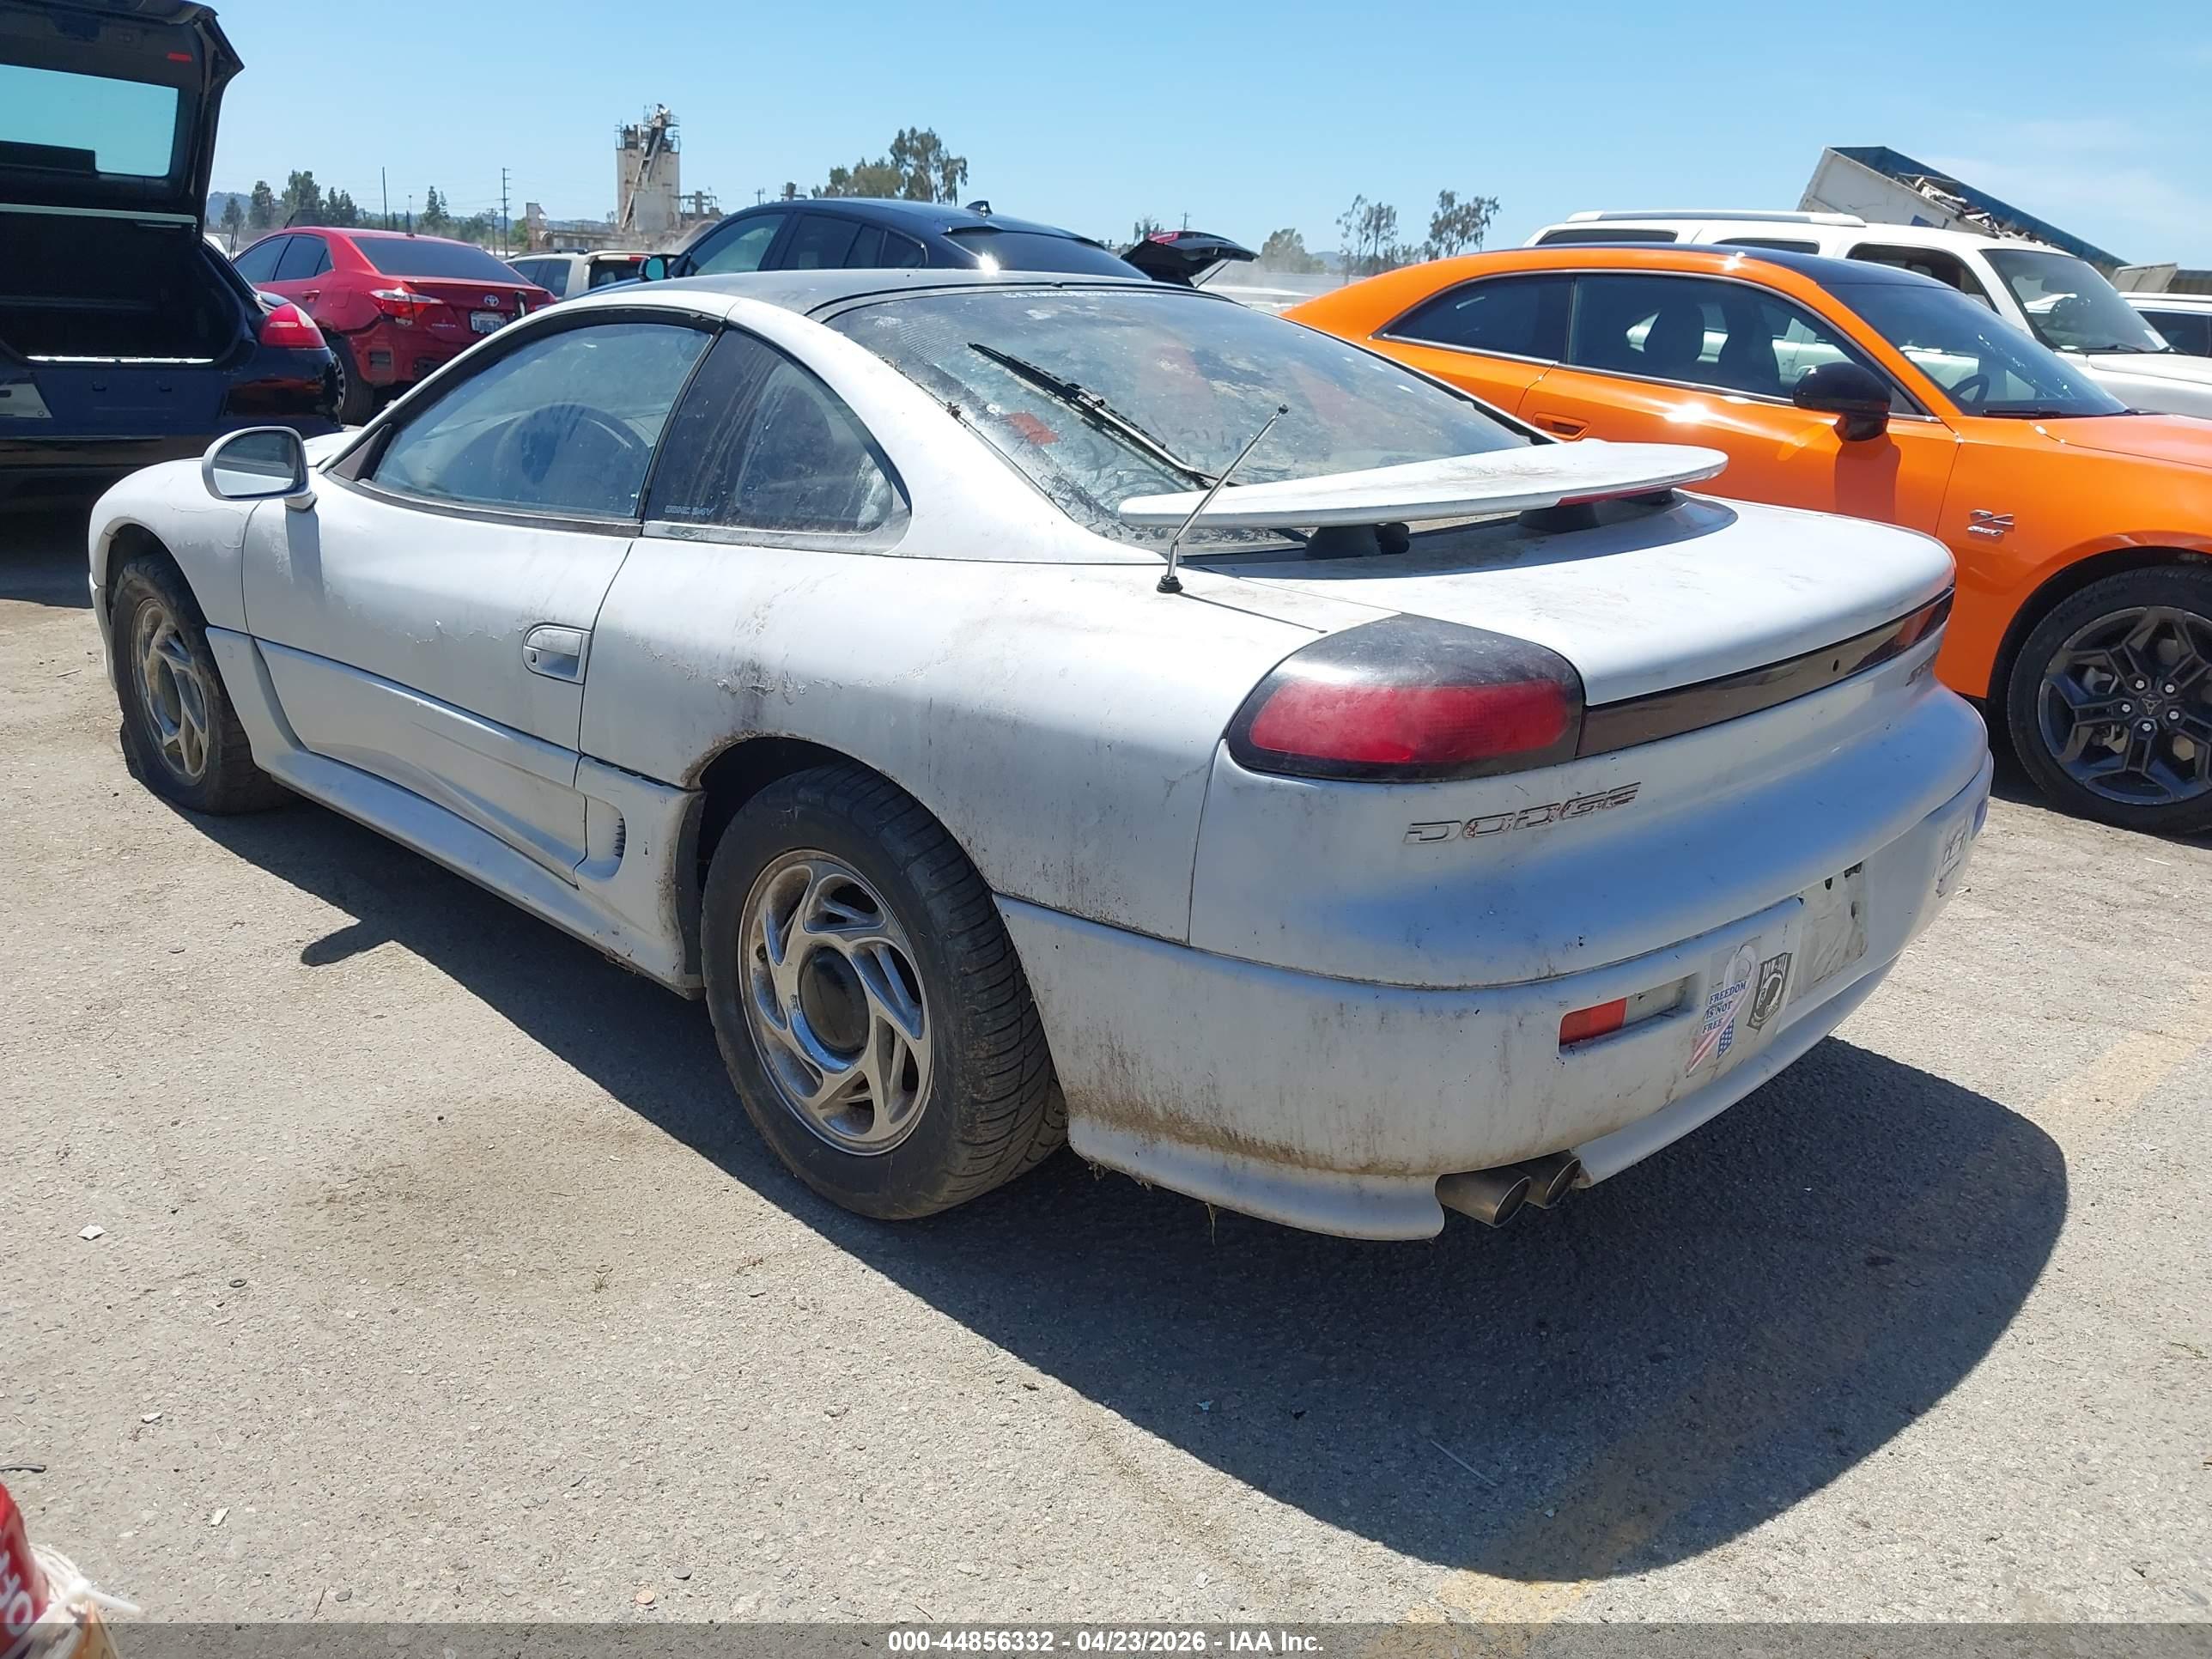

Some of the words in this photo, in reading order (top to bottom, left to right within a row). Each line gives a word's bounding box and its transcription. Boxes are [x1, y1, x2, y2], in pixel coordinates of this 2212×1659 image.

[1403, 781, 1641, 844] DODGE
[1709, 981, 1747, 1005] FREEDOM
[1705, 1006, 1714, 1019] IS
[1717, 1000, 1733, 1015] NOT
[1702, 1018, 1723, 1035] FREE
